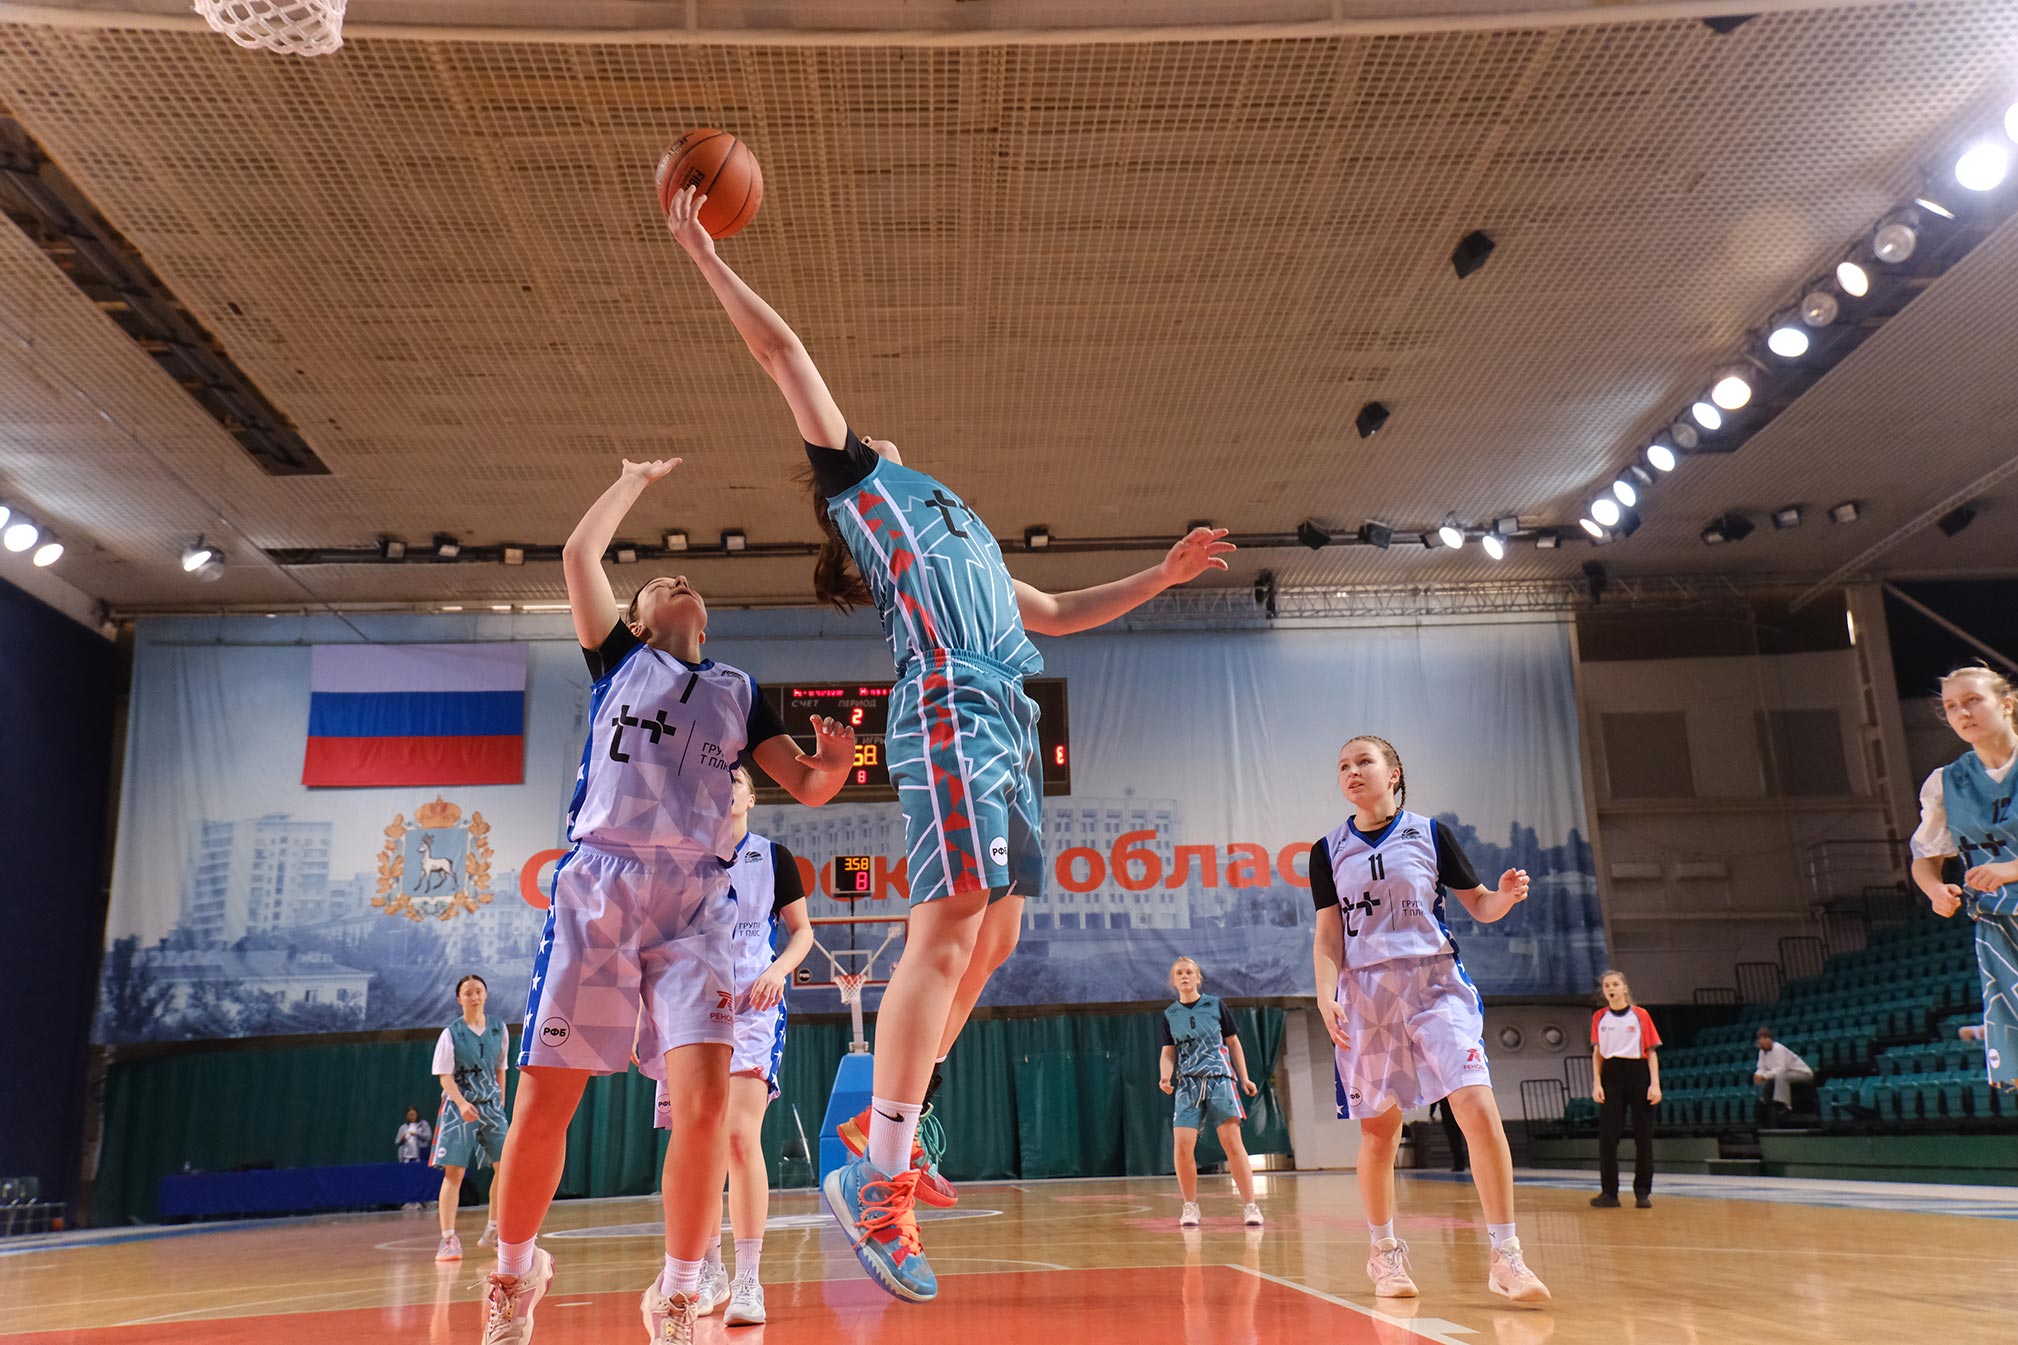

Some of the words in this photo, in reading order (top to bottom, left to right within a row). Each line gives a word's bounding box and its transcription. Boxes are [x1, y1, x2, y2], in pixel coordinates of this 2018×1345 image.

[838, 699, 876, 707] ПЕРИОД
[851, 708, 863, 725] 2
[702, 742, 724, 757] ГРУ
[700, 753, 708, 764] Т
[708, 756, 730, 772] ПЛЮ
[857, 770, 866, 783] 8
[1992, 797, 2011, 824] 12
[1055, 829, 1311, 893] облас
[1368, 853, 1385, 880] 11
[855, 871, 868, 890] 8
[1401, 900, 1424, 908] ГРУП
[1189, 1015, 1196, 1029] 6
[543, 1027, 567, 1037] РФБ
